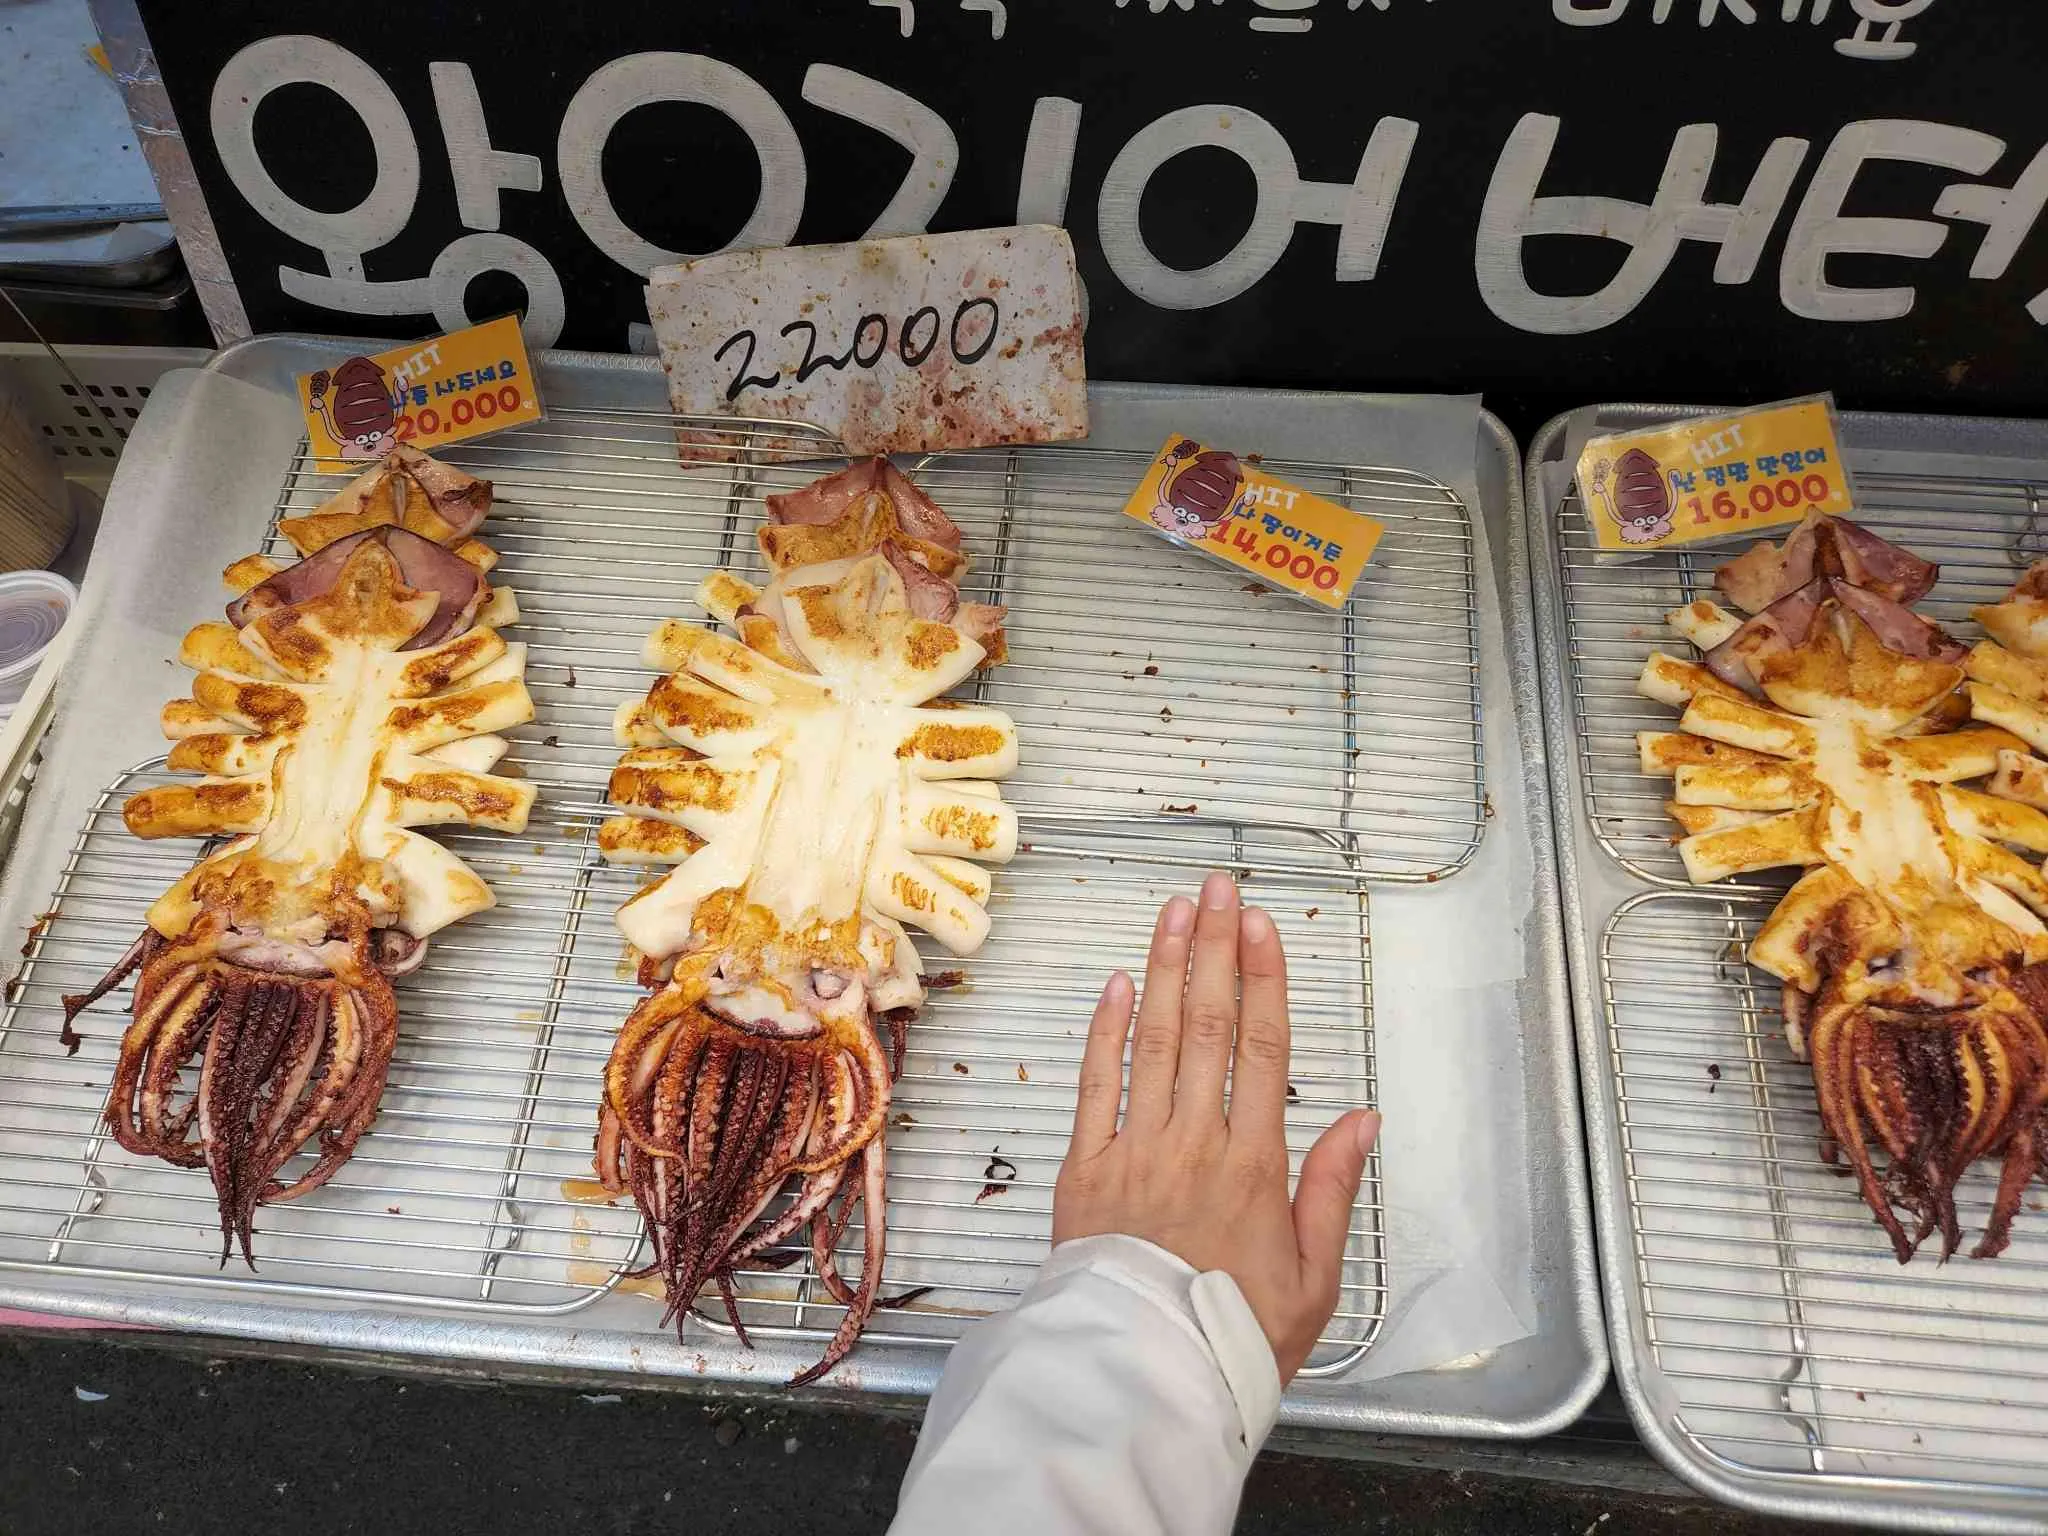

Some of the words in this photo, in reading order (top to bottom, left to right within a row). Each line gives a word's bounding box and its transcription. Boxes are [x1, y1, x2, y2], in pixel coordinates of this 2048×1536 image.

[391, 343, 442, 383] HIT
[714, 296, 1000, 401] 22000
[1690, 423, 1745, 465] HIT
[1244, 481, 1300, 512] HIT
